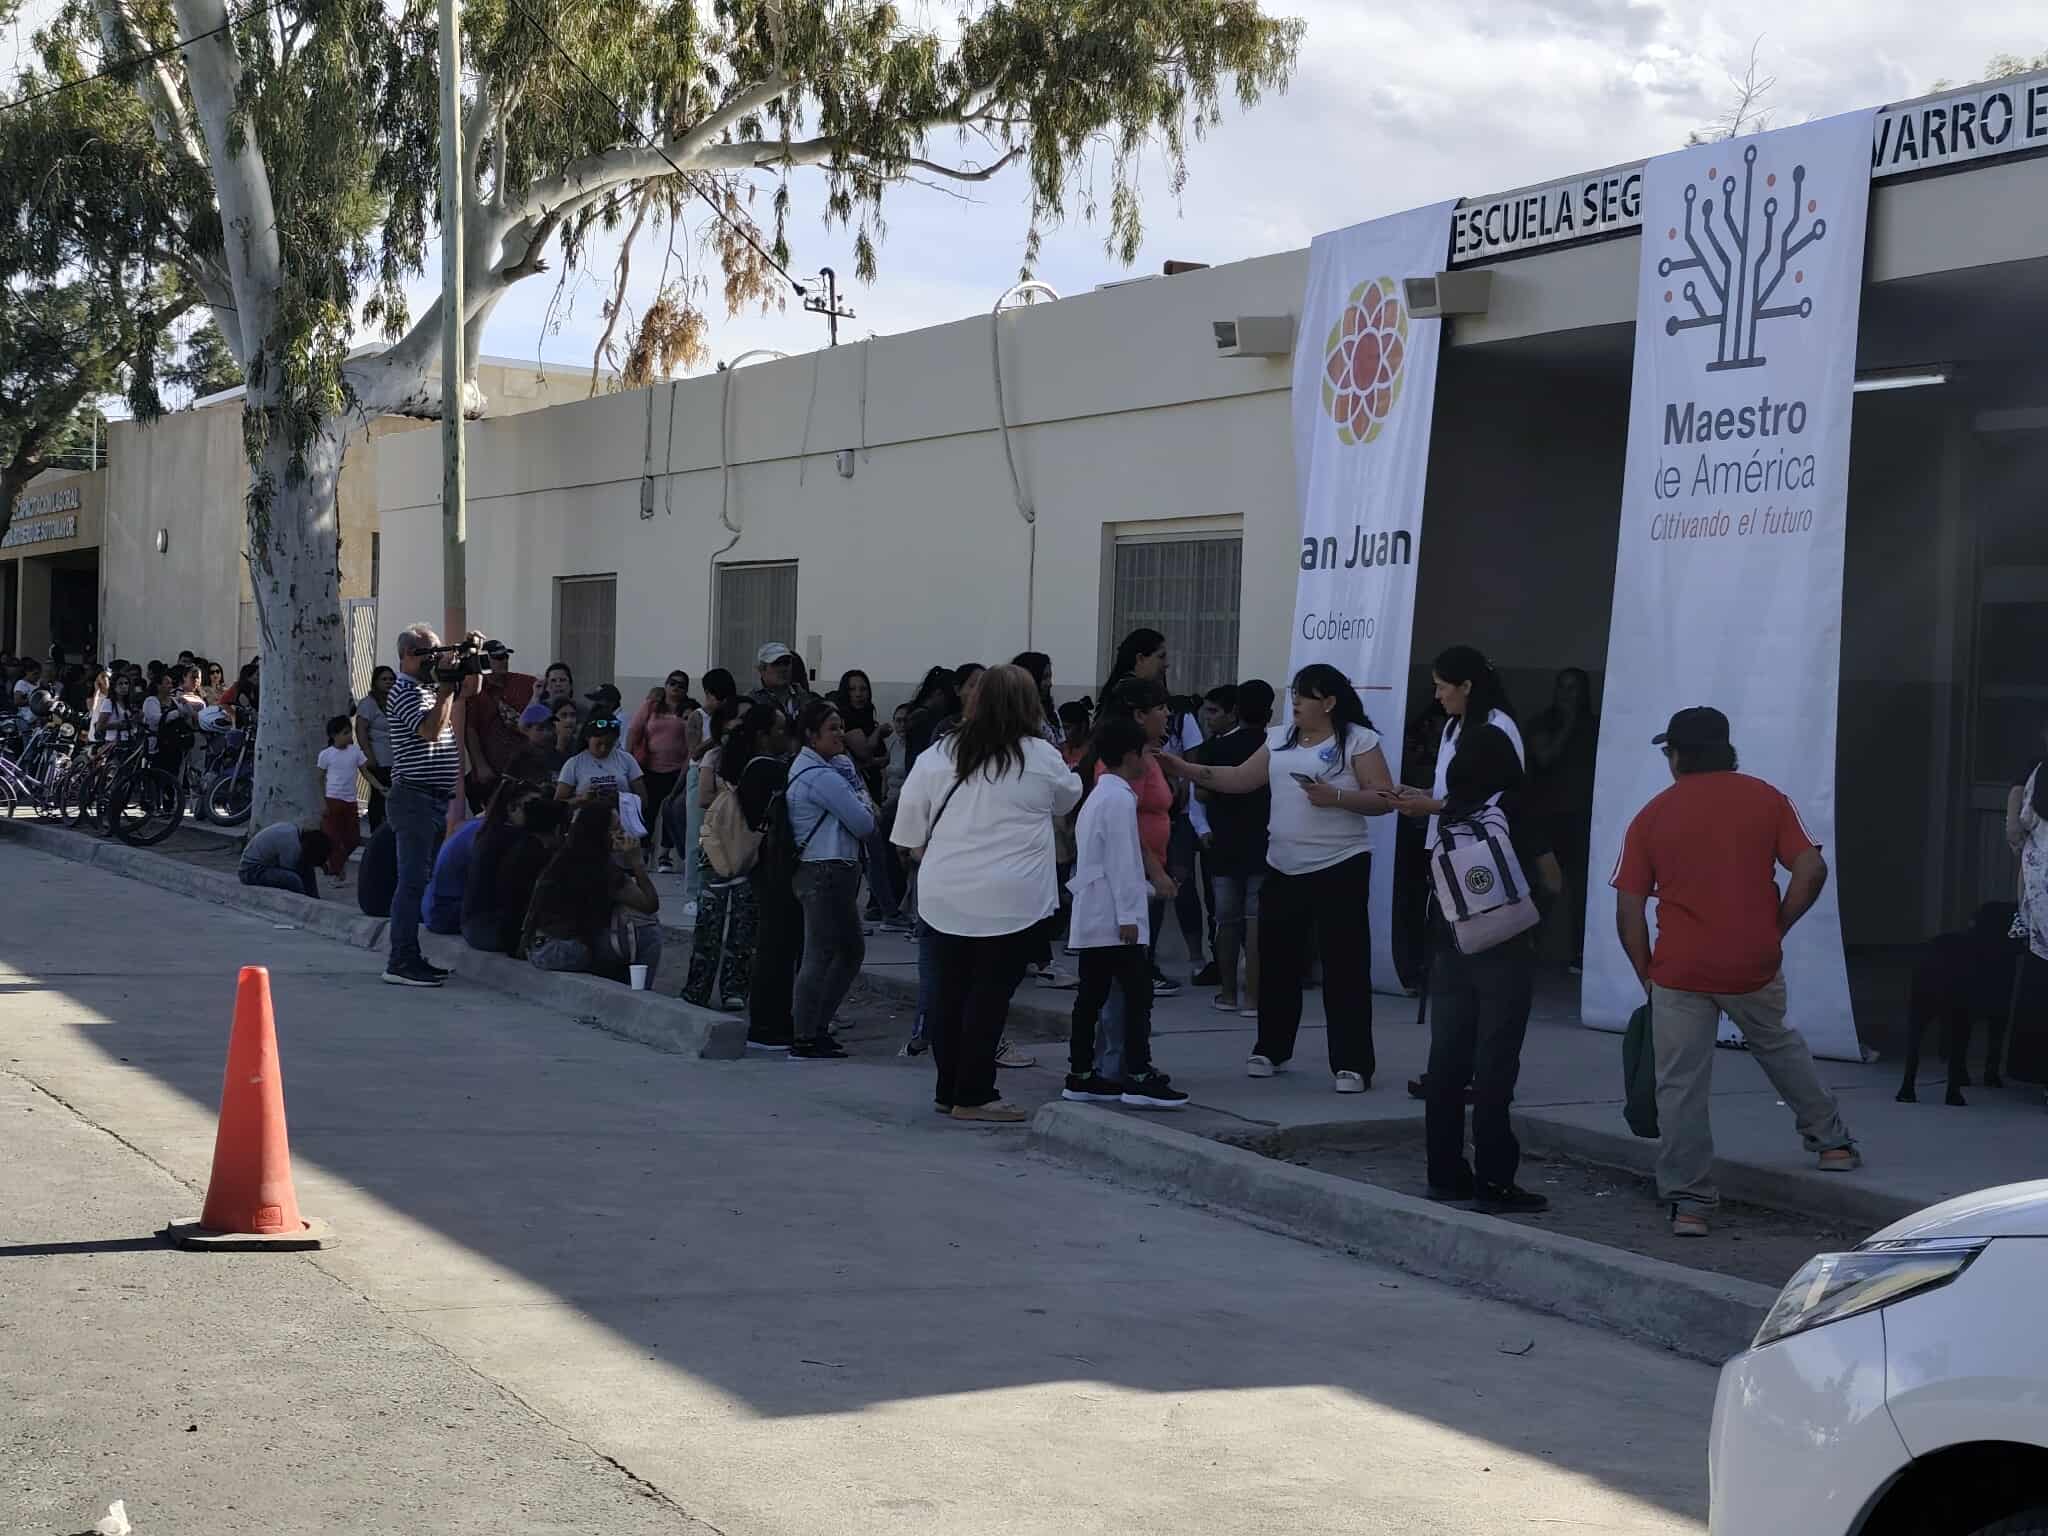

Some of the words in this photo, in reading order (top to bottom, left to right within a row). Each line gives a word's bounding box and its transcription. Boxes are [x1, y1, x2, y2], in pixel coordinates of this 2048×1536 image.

[1455, 190, 1574, 254] ESCUELA
[1582, 174, 1641, 227] SEG
[1663, 396, 1807, 445] Maestro
[1691, 447, 1815, 497] América
[1738, 507, 1758, 536] el
[1762, 506, 1813, 534] futuro
[1344, 525, 1412, 569] Juan
[1302, 611, 1375, 641] Gobierno
